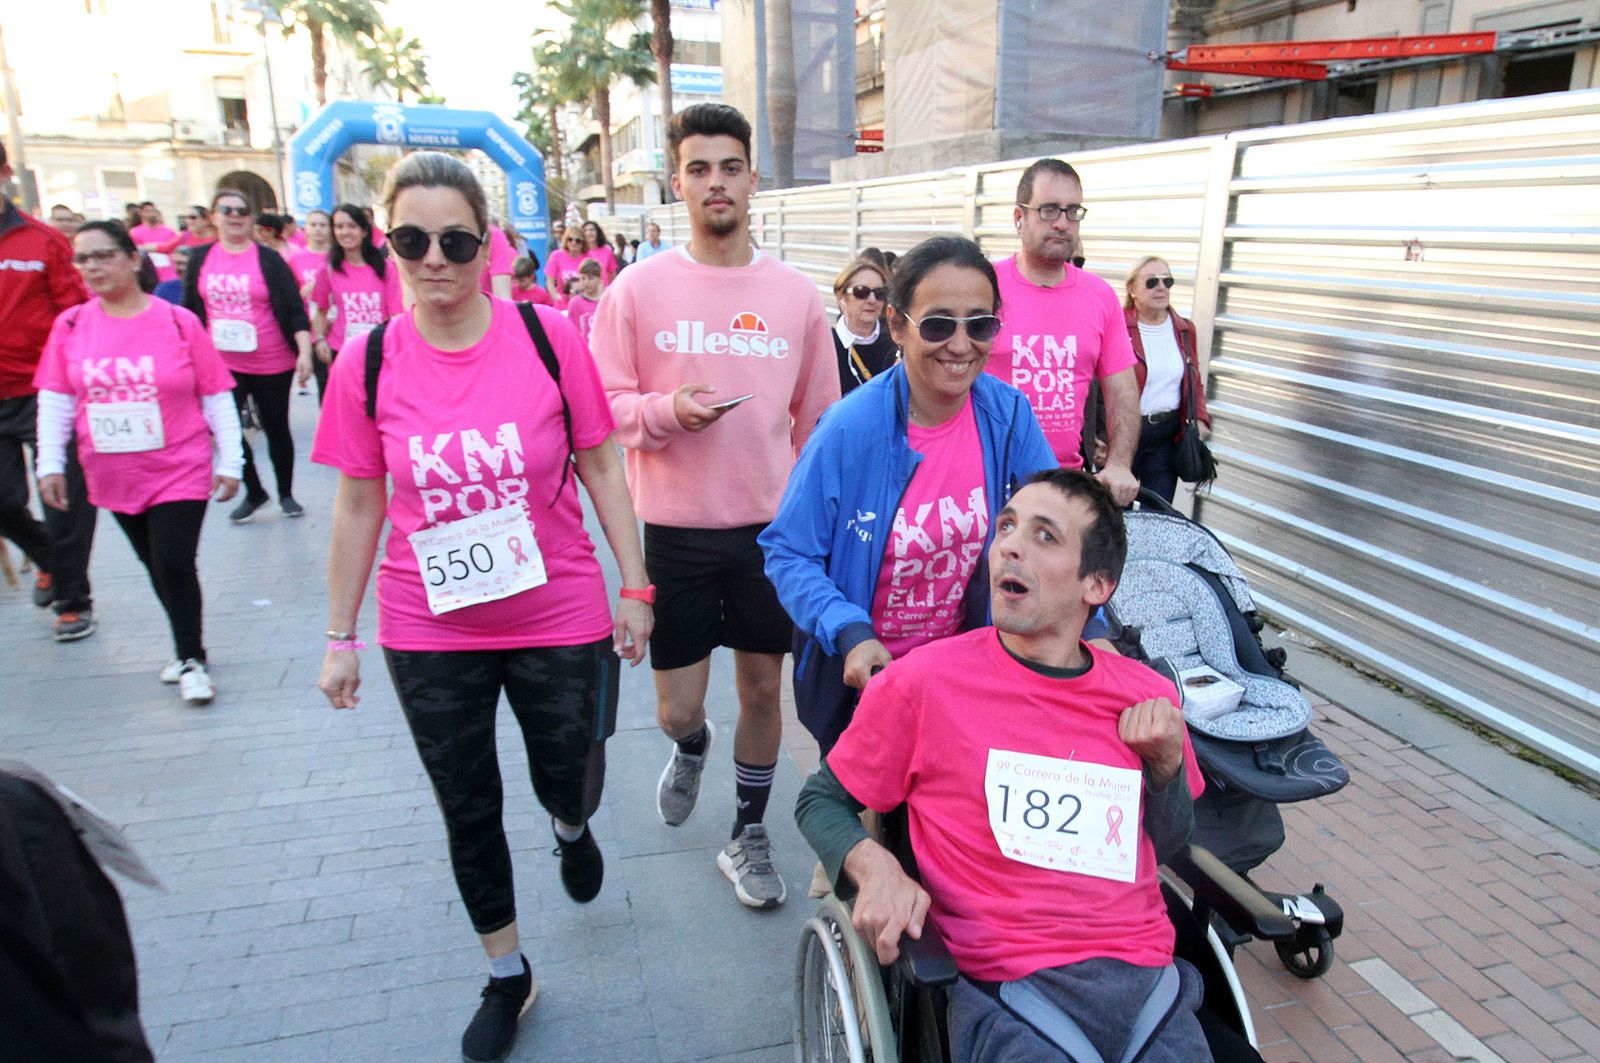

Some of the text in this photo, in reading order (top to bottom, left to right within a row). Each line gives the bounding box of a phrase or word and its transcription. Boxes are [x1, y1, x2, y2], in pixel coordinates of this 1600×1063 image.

[206, 273, 250, 292] KM
[341, 291, 382, 311] KM
[654, 319, 789, 359] ellesse
[1012, 334, 1077, 369] KM
[82, 355, 155, 387] KM
[1012, 368, 1075, 393] POR
[408, 422, 526, 487] KM
[420, 477, 531, 524] POR
[892, 487, 989, 557] KM
[427, 543, 494, 587] 550
[1014, 763, 1061, 781] Carrera
[1065, 771, 1080, 785] de
[1084, 773, 1095, 787] la
[1099, 777, 1132, 794] Mujer
[998, 784, 1082, 835] 182
